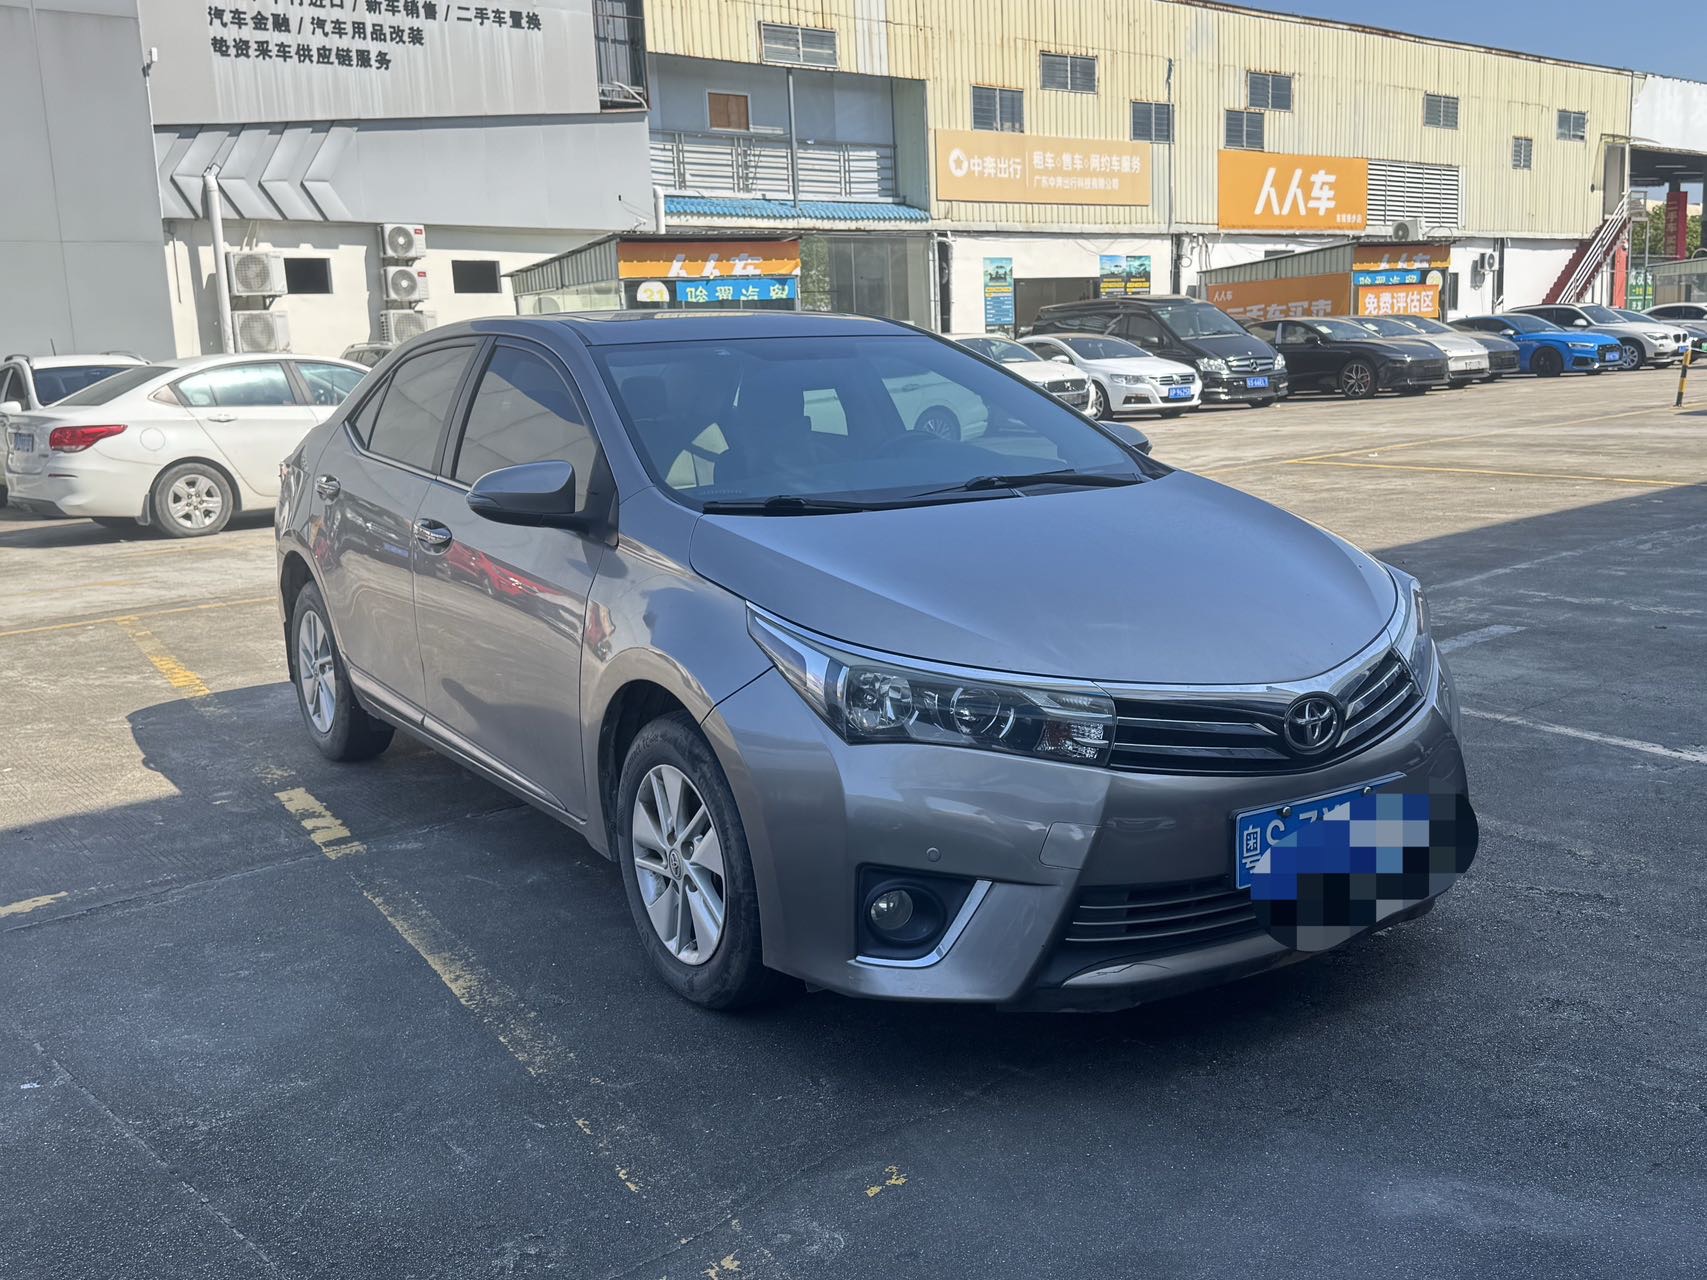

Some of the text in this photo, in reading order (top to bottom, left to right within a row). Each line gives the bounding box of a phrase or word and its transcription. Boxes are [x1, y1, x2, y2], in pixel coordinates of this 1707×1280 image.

[208, 6, 292, 33] 汽车金融
[311, 16, 425, 46] 汽车用品改装
[456, 6, 542, 31] 二手车置换
[1253, 167, 1337, 216] 人人车
[1364, 290, 1434, 316] 免费评估区
